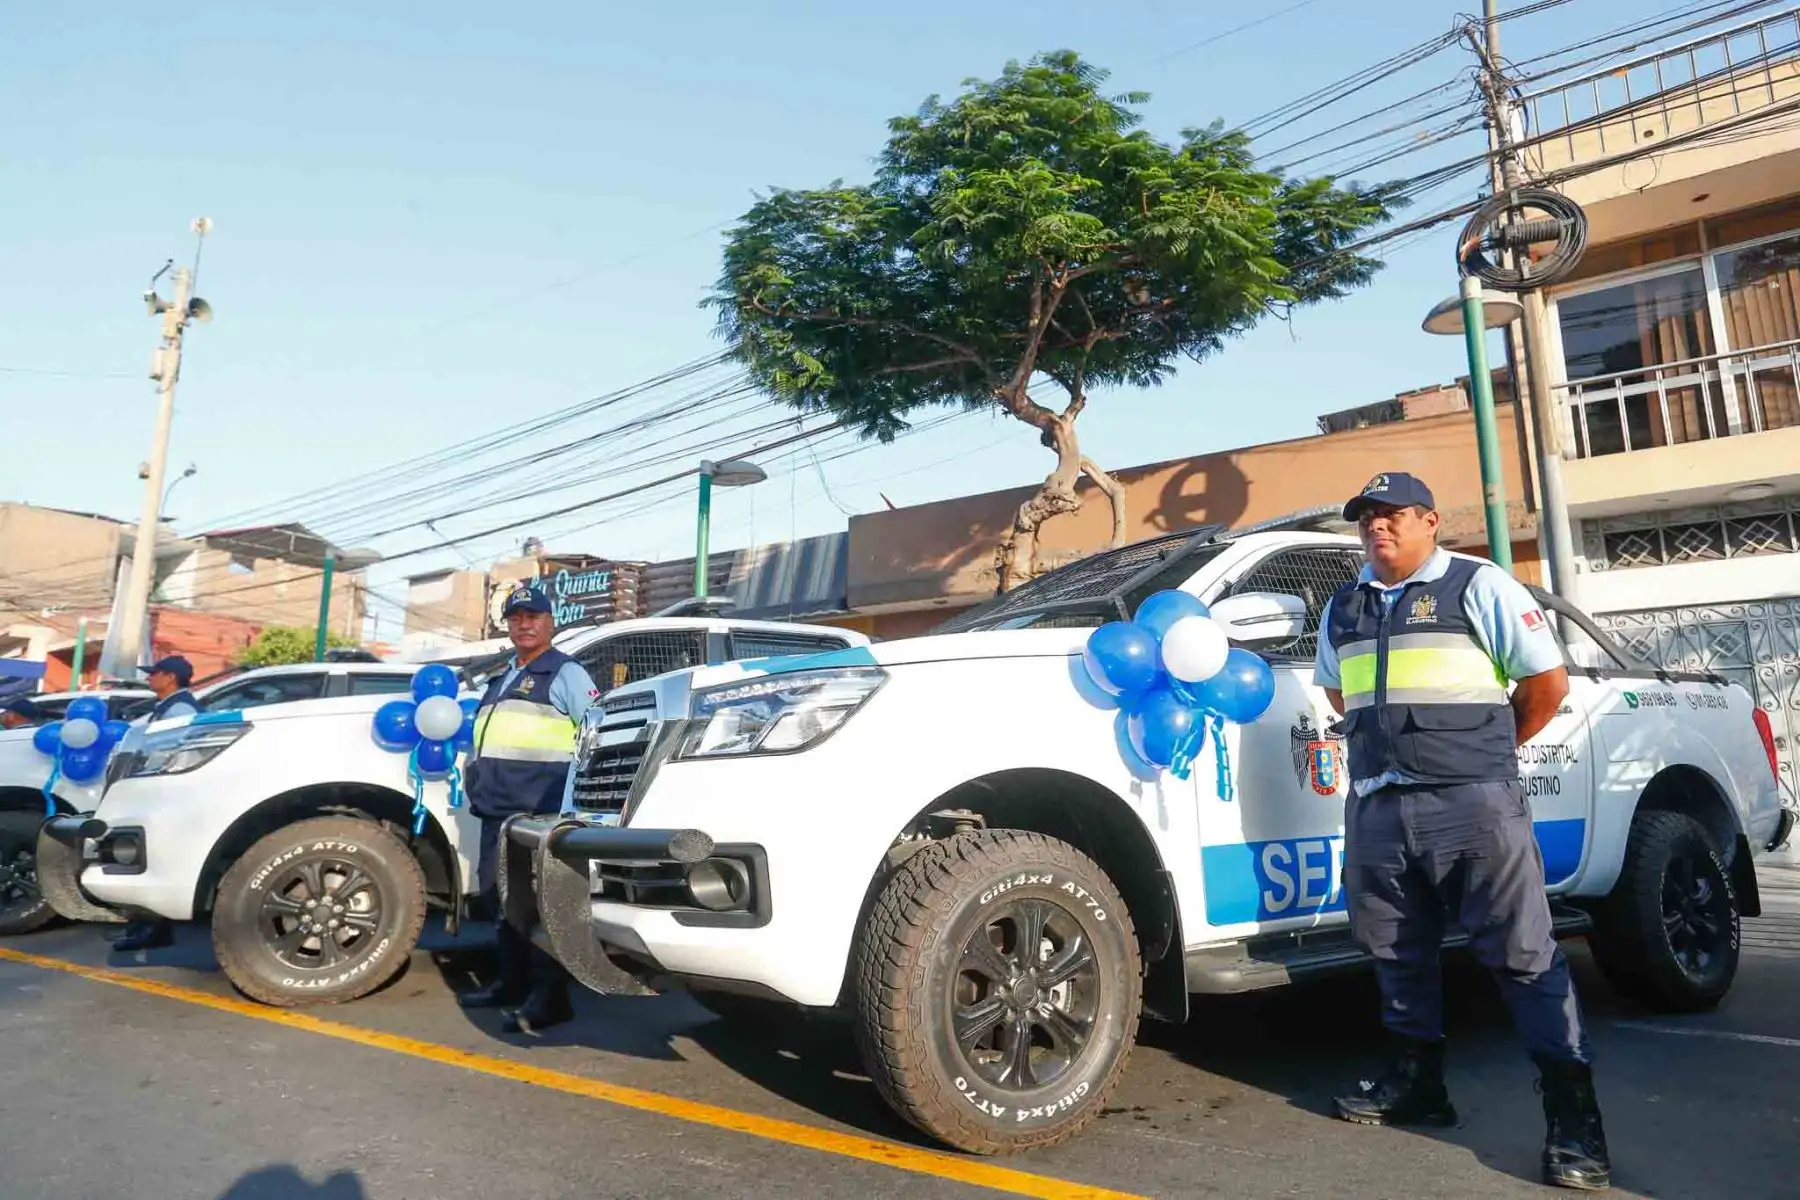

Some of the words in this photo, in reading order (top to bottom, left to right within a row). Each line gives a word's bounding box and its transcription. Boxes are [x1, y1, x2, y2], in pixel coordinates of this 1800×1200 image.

[555, 569, 609, 598] Quinta
[551, 598, 585, 627] Nota
[1531, 744, 1578, 764] DISTRITAL
[312, 841, 358, 853] AT70
[1061, 881, 1107, 921] AT70
[954, 1076, 1006, 1118] AT70
